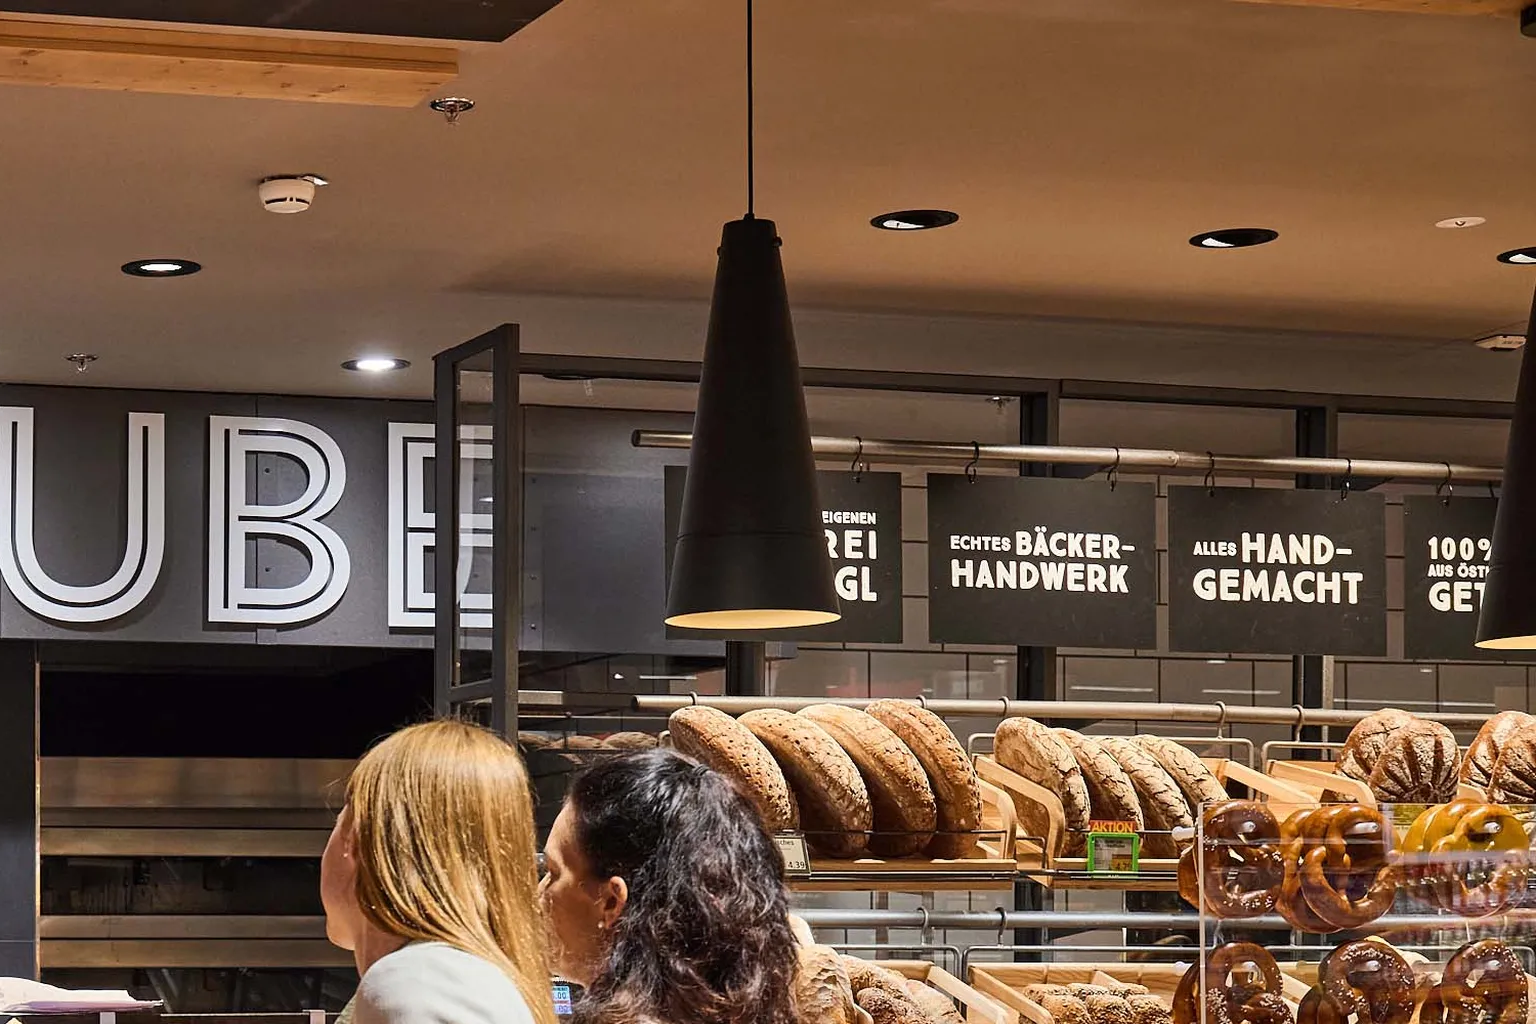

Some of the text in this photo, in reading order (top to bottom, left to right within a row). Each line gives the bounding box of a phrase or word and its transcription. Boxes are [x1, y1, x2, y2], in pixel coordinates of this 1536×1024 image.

[950, 525, 1135, 559] ECHTES BÄCKER-
[1193, 532, 1352, 565] ALLES HAND-
[950, 558, 1129, 593] HANDWERK
[1192, 568, 1364, 604] GEMACHT
[1427, 564, 1453, 578] AUS
[1092, 821, 1134, 832] AKTION
